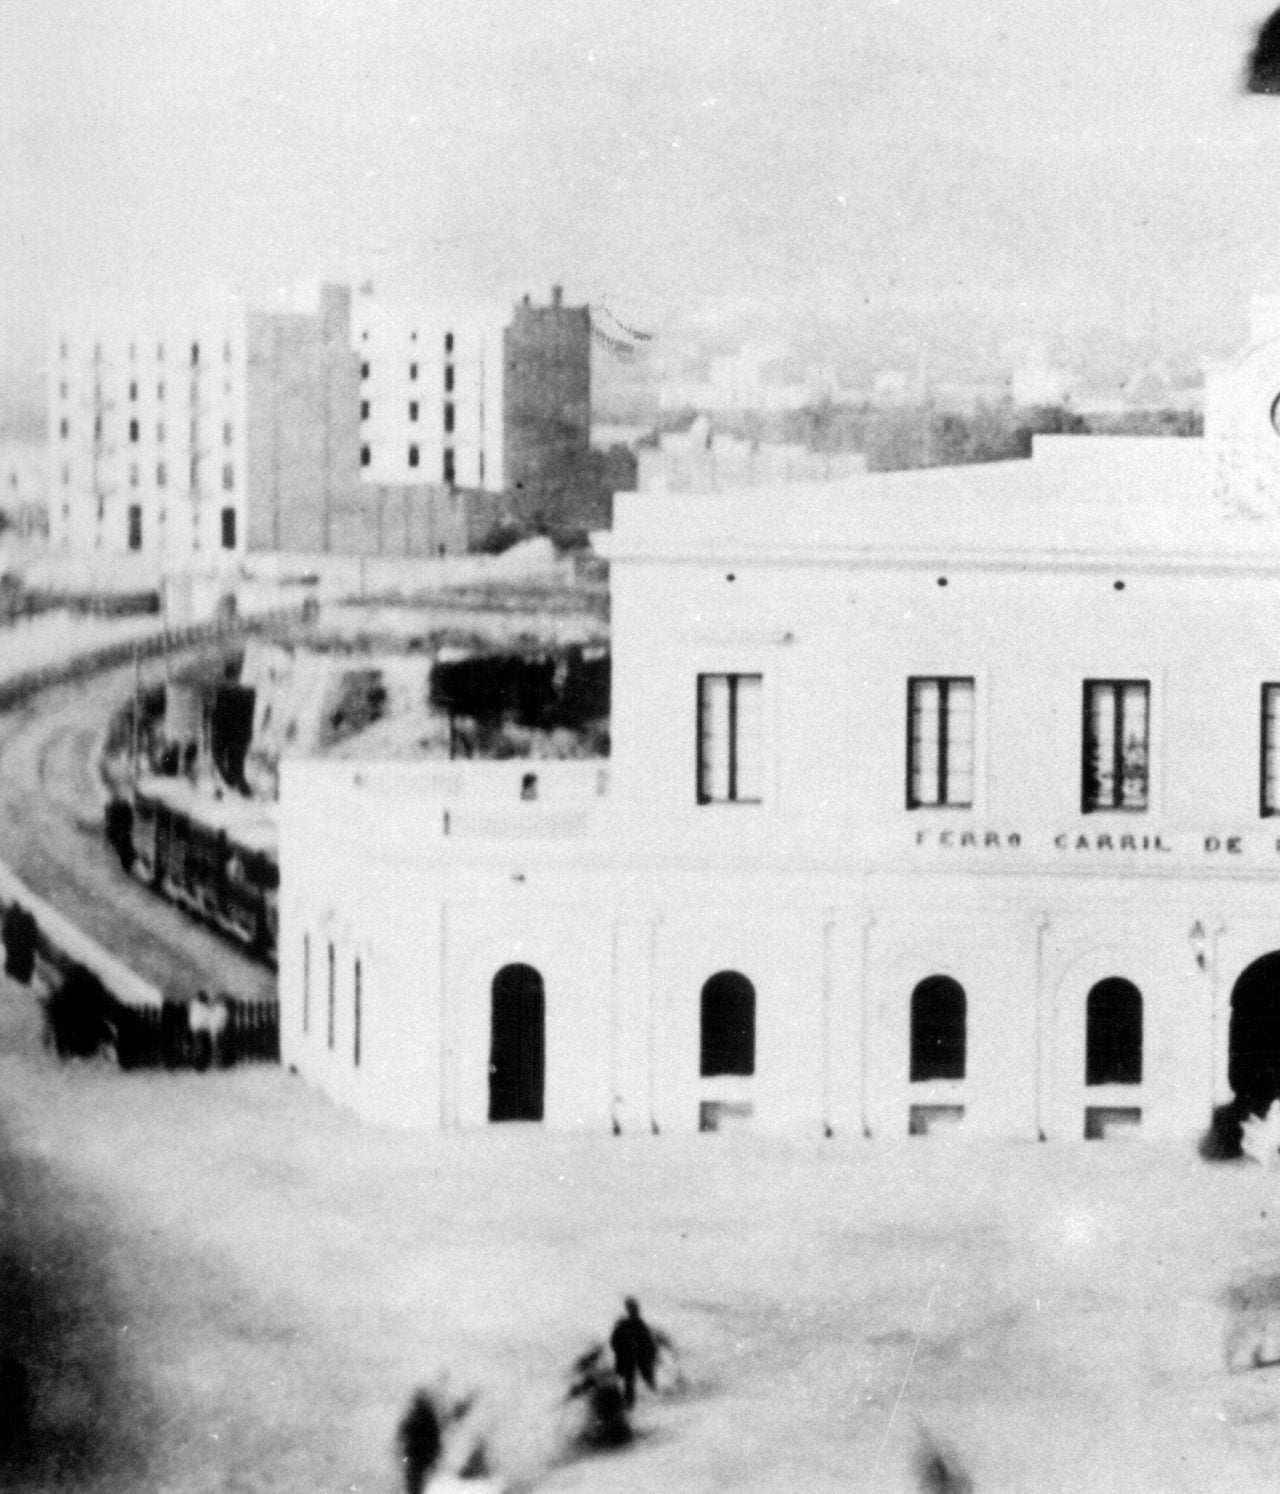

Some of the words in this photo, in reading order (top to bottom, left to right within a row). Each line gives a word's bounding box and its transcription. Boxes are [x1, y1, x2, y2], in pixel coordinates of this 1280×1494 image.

[914, 830, 1023, 850] FERRO
[1052, 833, 1172, 853] CARRIL
[1202, 835, 1244, 855] DE
